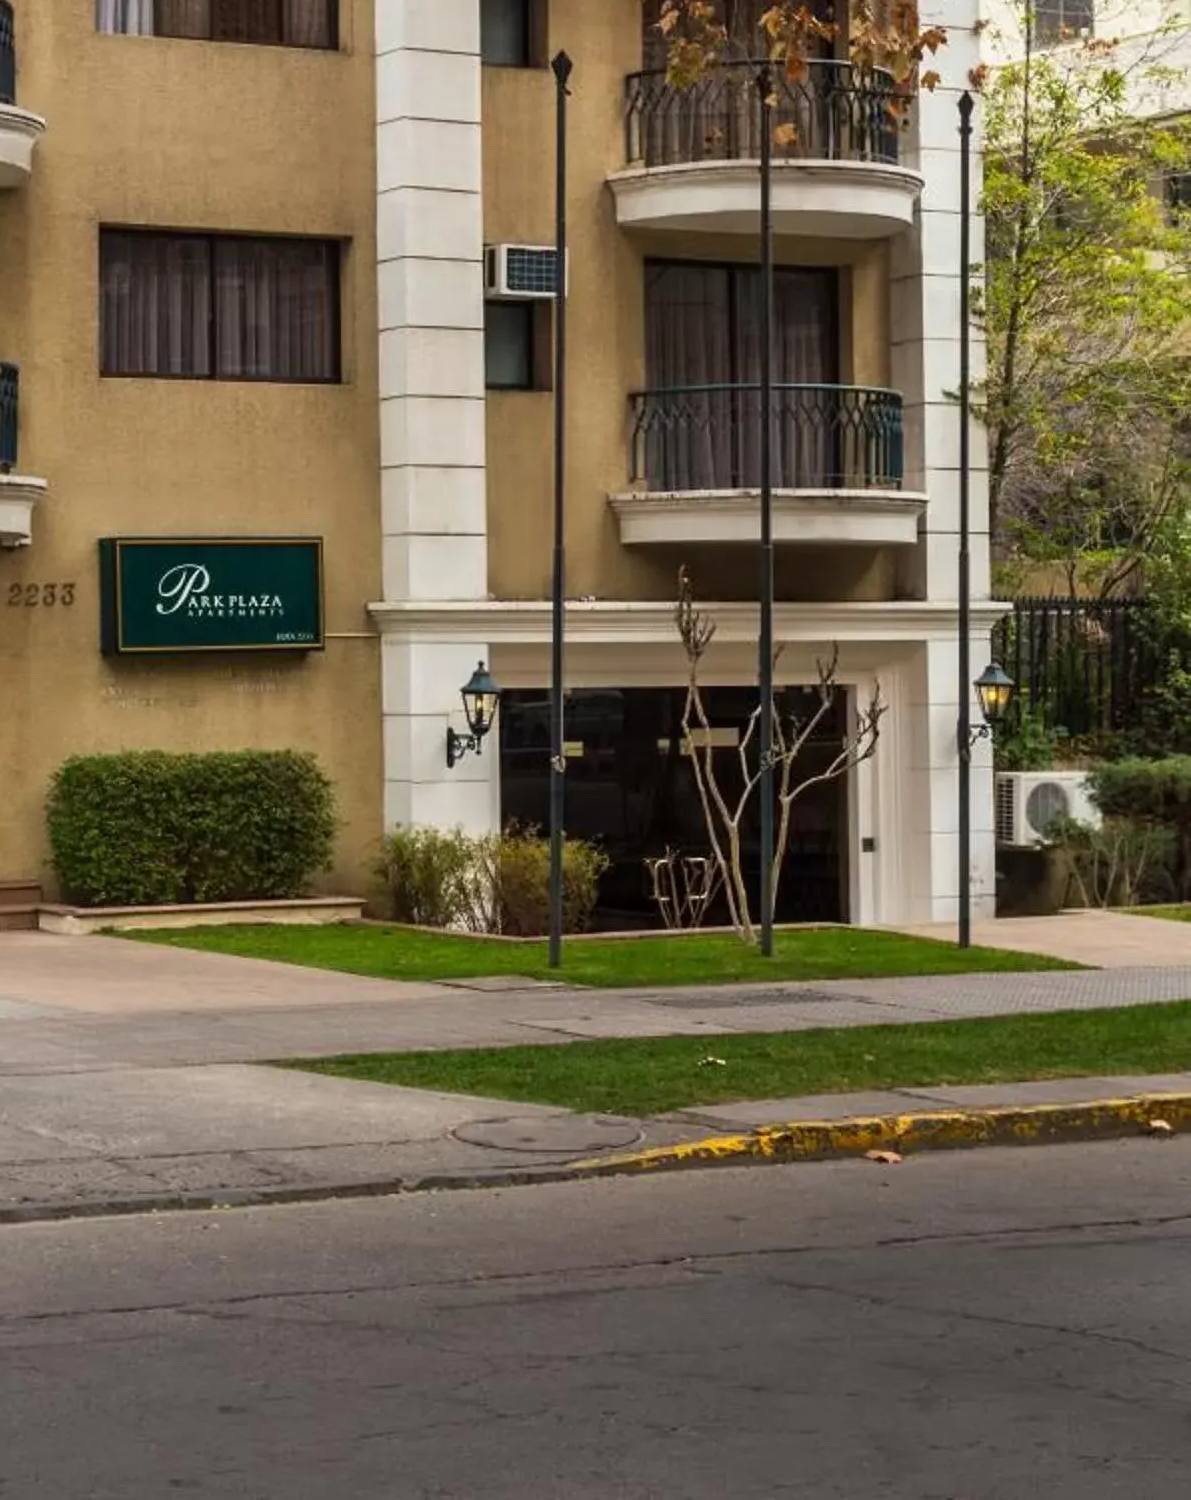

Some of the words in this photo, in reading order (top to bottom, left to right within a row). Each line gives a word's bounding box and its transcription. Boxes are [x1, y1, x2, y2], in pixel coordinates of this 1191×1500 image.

[7, 582, 76, 607] 2233
[156, 563, 224, 615] PARK
[228, 595, 283, 608] PLAZA
